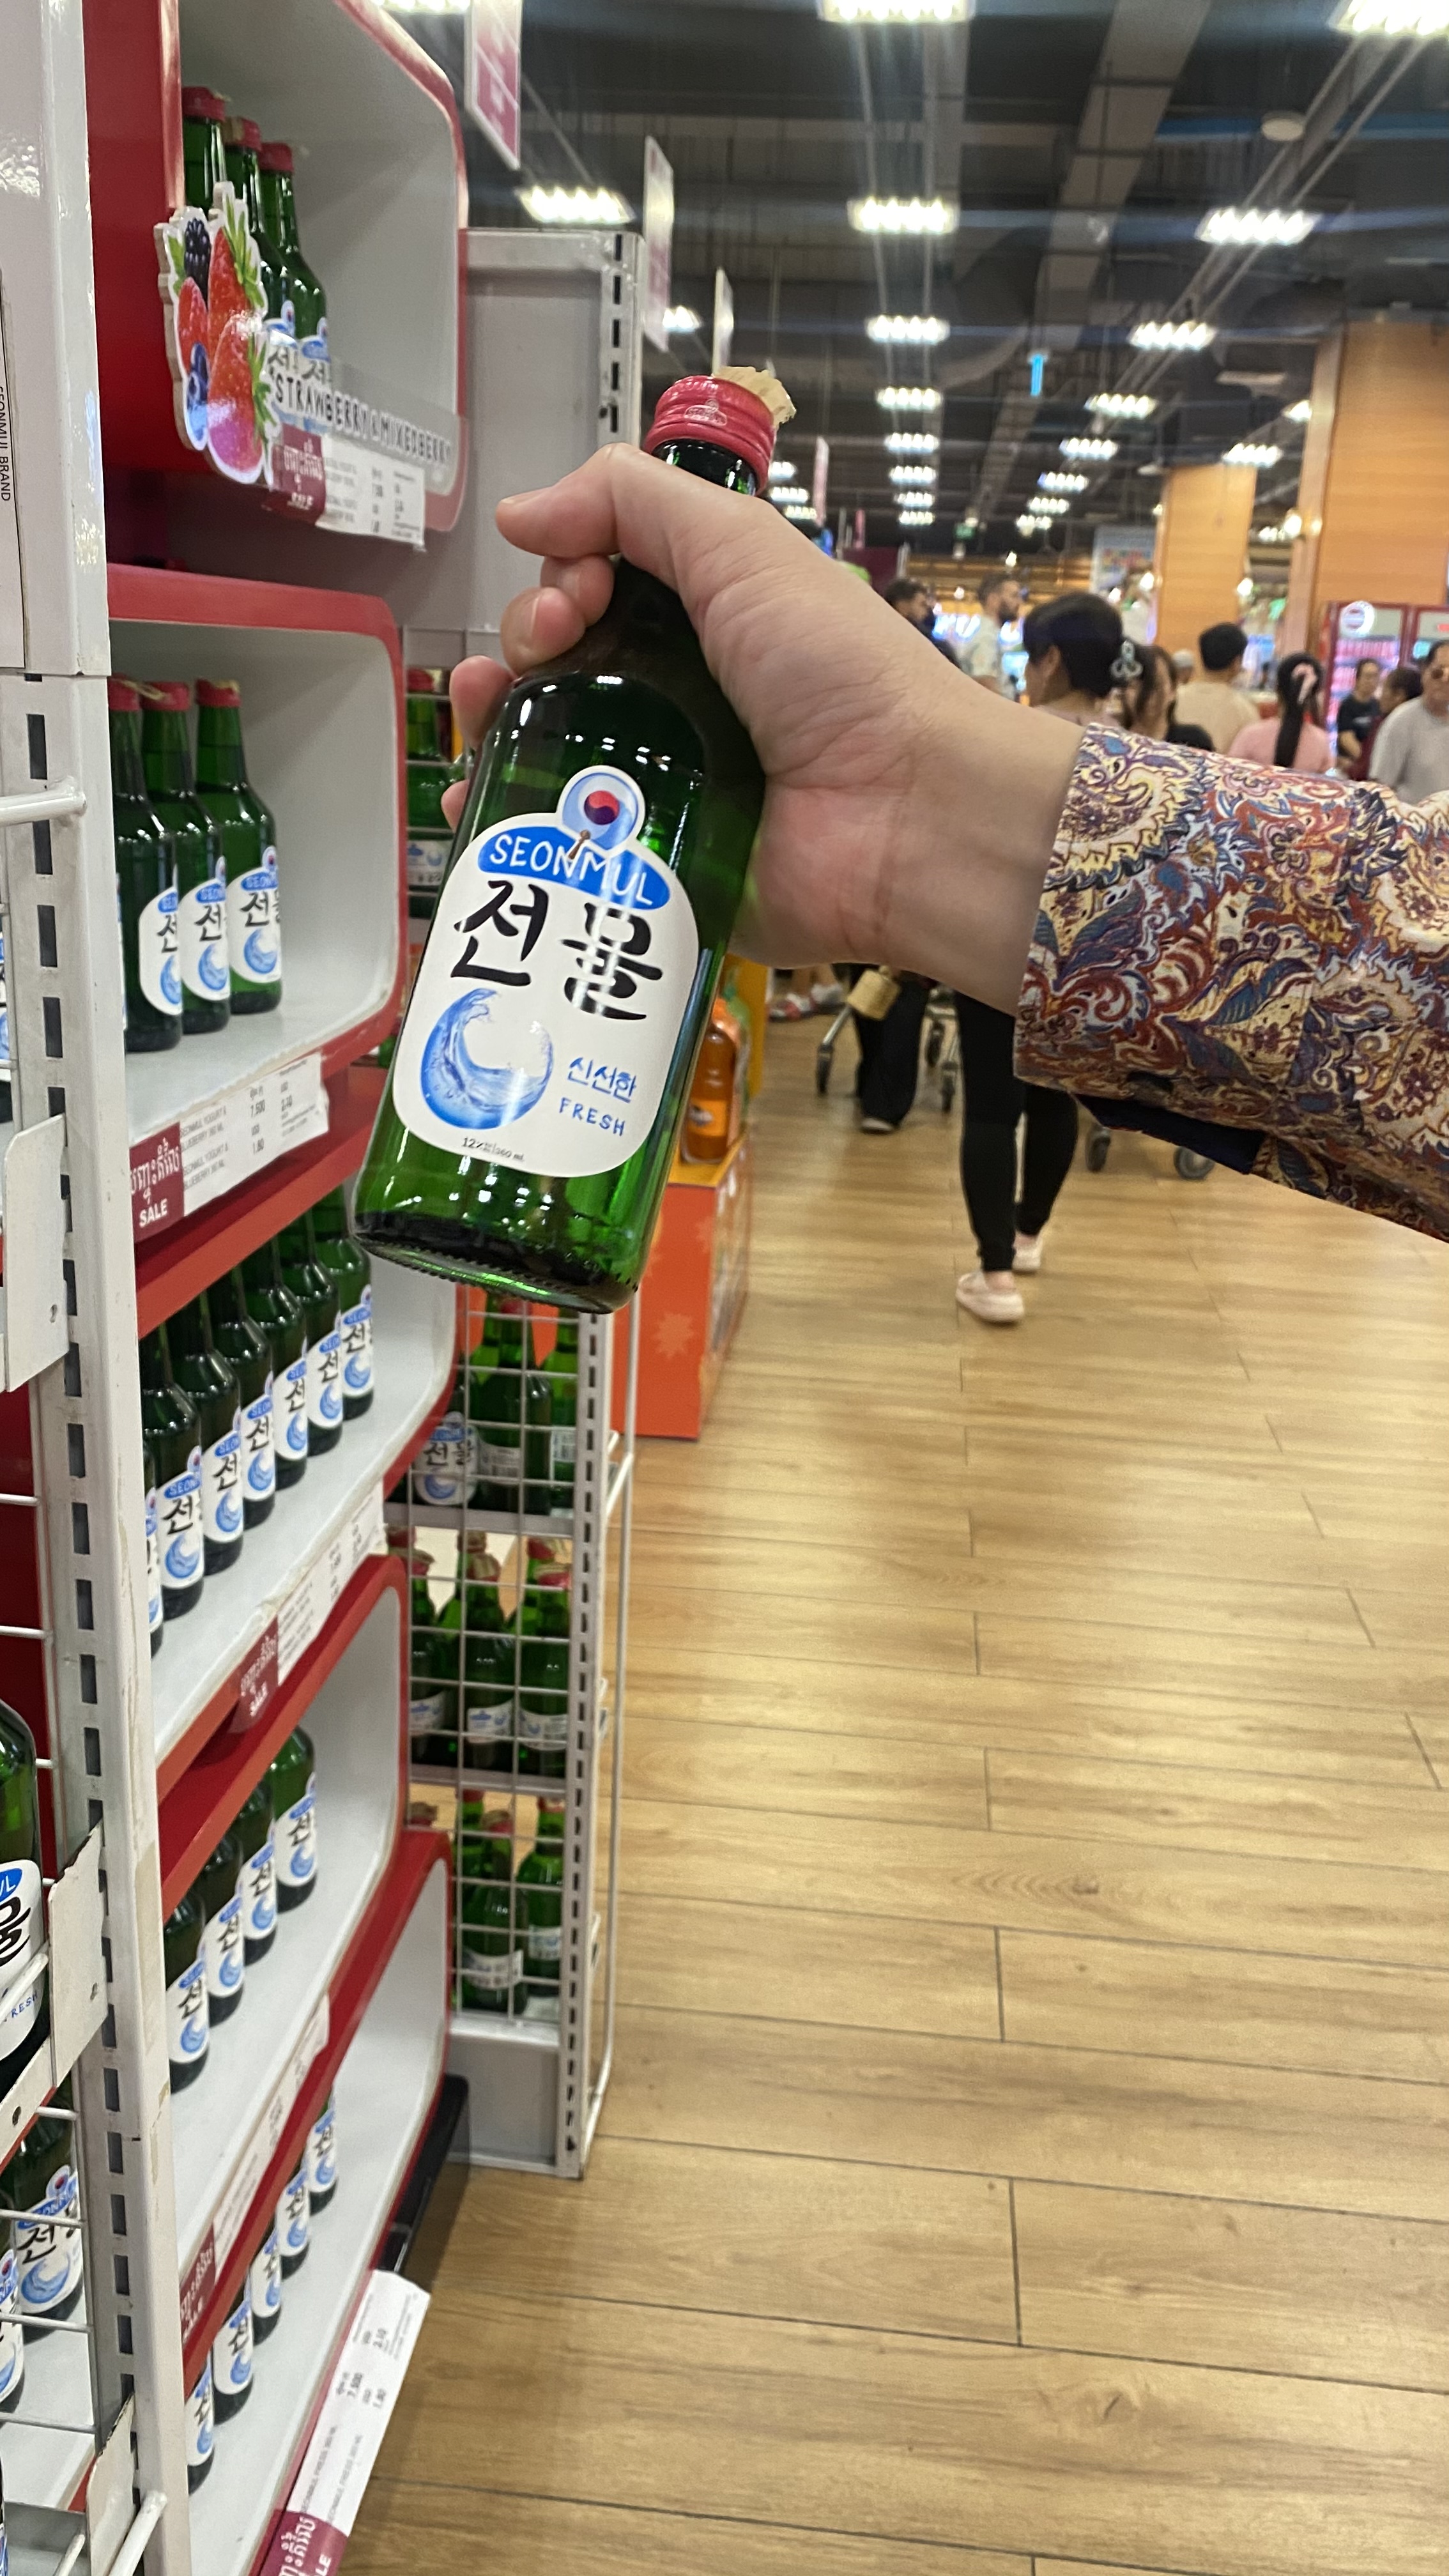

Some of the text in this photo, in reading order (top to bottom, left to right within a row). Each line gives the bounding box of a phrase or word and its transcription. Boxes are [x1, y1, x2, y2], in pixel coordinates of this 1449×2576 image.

[275, 372, 369, 433] STRAWBERRY
[0, 456, 11, 502] BRAND
[489, 832, 653, 906] SEONMUL
[567, 1056, 637, 1104] 신선한
[558, 1097, 626, 1137] FRESH
[139, 1198, 168, 1228] SALE
[3, 1991, 38, 2022] RESH
